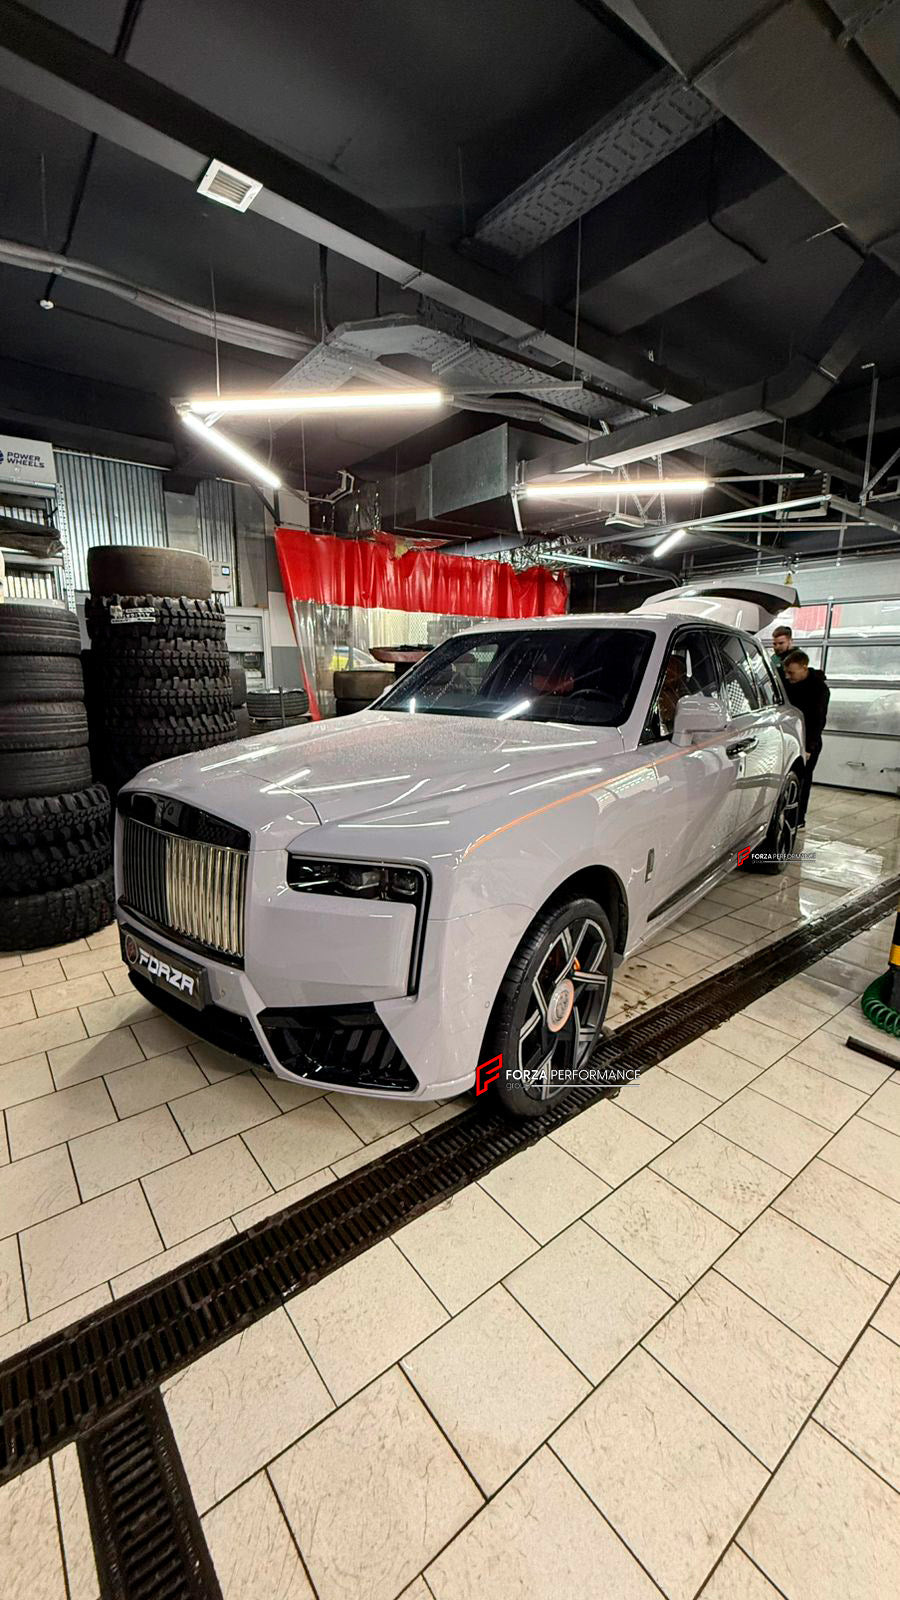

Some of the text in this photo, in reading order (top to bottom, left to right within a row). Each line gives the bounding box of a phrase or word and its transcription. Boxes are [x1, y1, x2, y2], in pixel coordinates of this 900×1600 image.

[7, 452, 41, 462] POWER
[7, 458, 46, 469] WHEELS
[139, 947, 195, 996] FORZA
